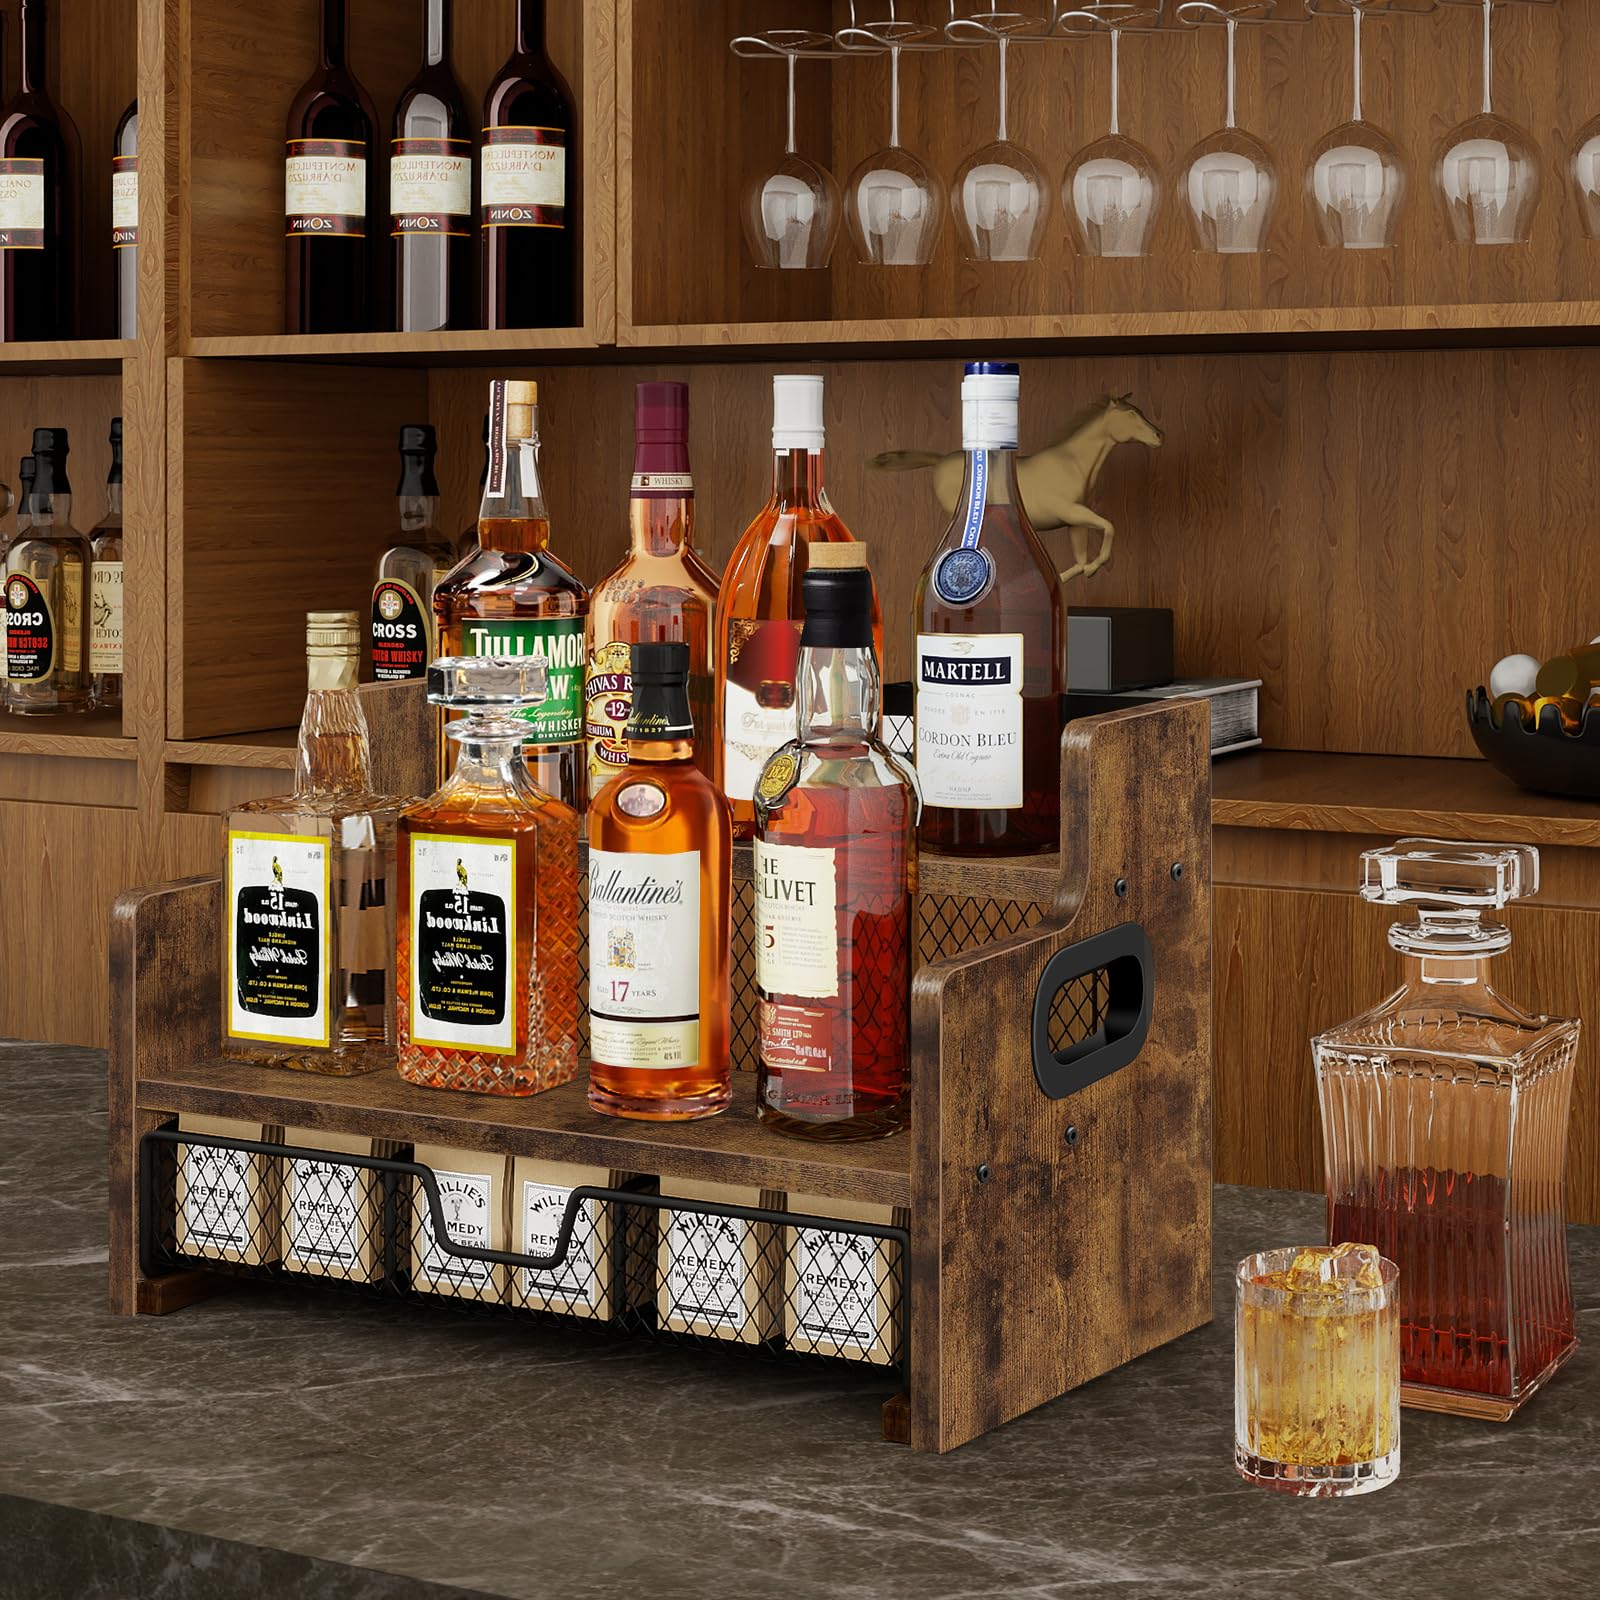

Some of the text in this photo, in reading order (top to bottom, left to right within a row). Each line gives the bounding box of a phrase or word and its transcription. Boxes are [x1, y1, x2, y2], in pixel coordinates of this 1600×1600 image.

[112, 231, 136, 243] ONIN
[654, 477, 683, 485] WHISKY
[966, 527, 976, 547] COR
[372, 622, 417, 639] CROSS
[390, 650, 424, 663] WHISKY
[469, 628, 586, 669] TULLAMOR
[924, 661, 1006, 681] MARTELL
[585, 675, 618, 701] CHIVAS
[610, 701, 625, 717] 12
[535, 717, 583, 733] WHISKEY
[918, 726, 1017, 747] CORDON BLEU
[600, 747, 629, 764] WHIS
[589, 858, 684, 905] Ballantine's
[610, 980, 630, 1002] 17
[632, 989, 657, 998] YEARS
[438, 1181, 486, 1209] ILLIE'S
[299, 1200, 351, 1216] REMEDY
[447, 1221, 484, 1236] MEDY
[806, 1273, 868, 1292] REMEDY
